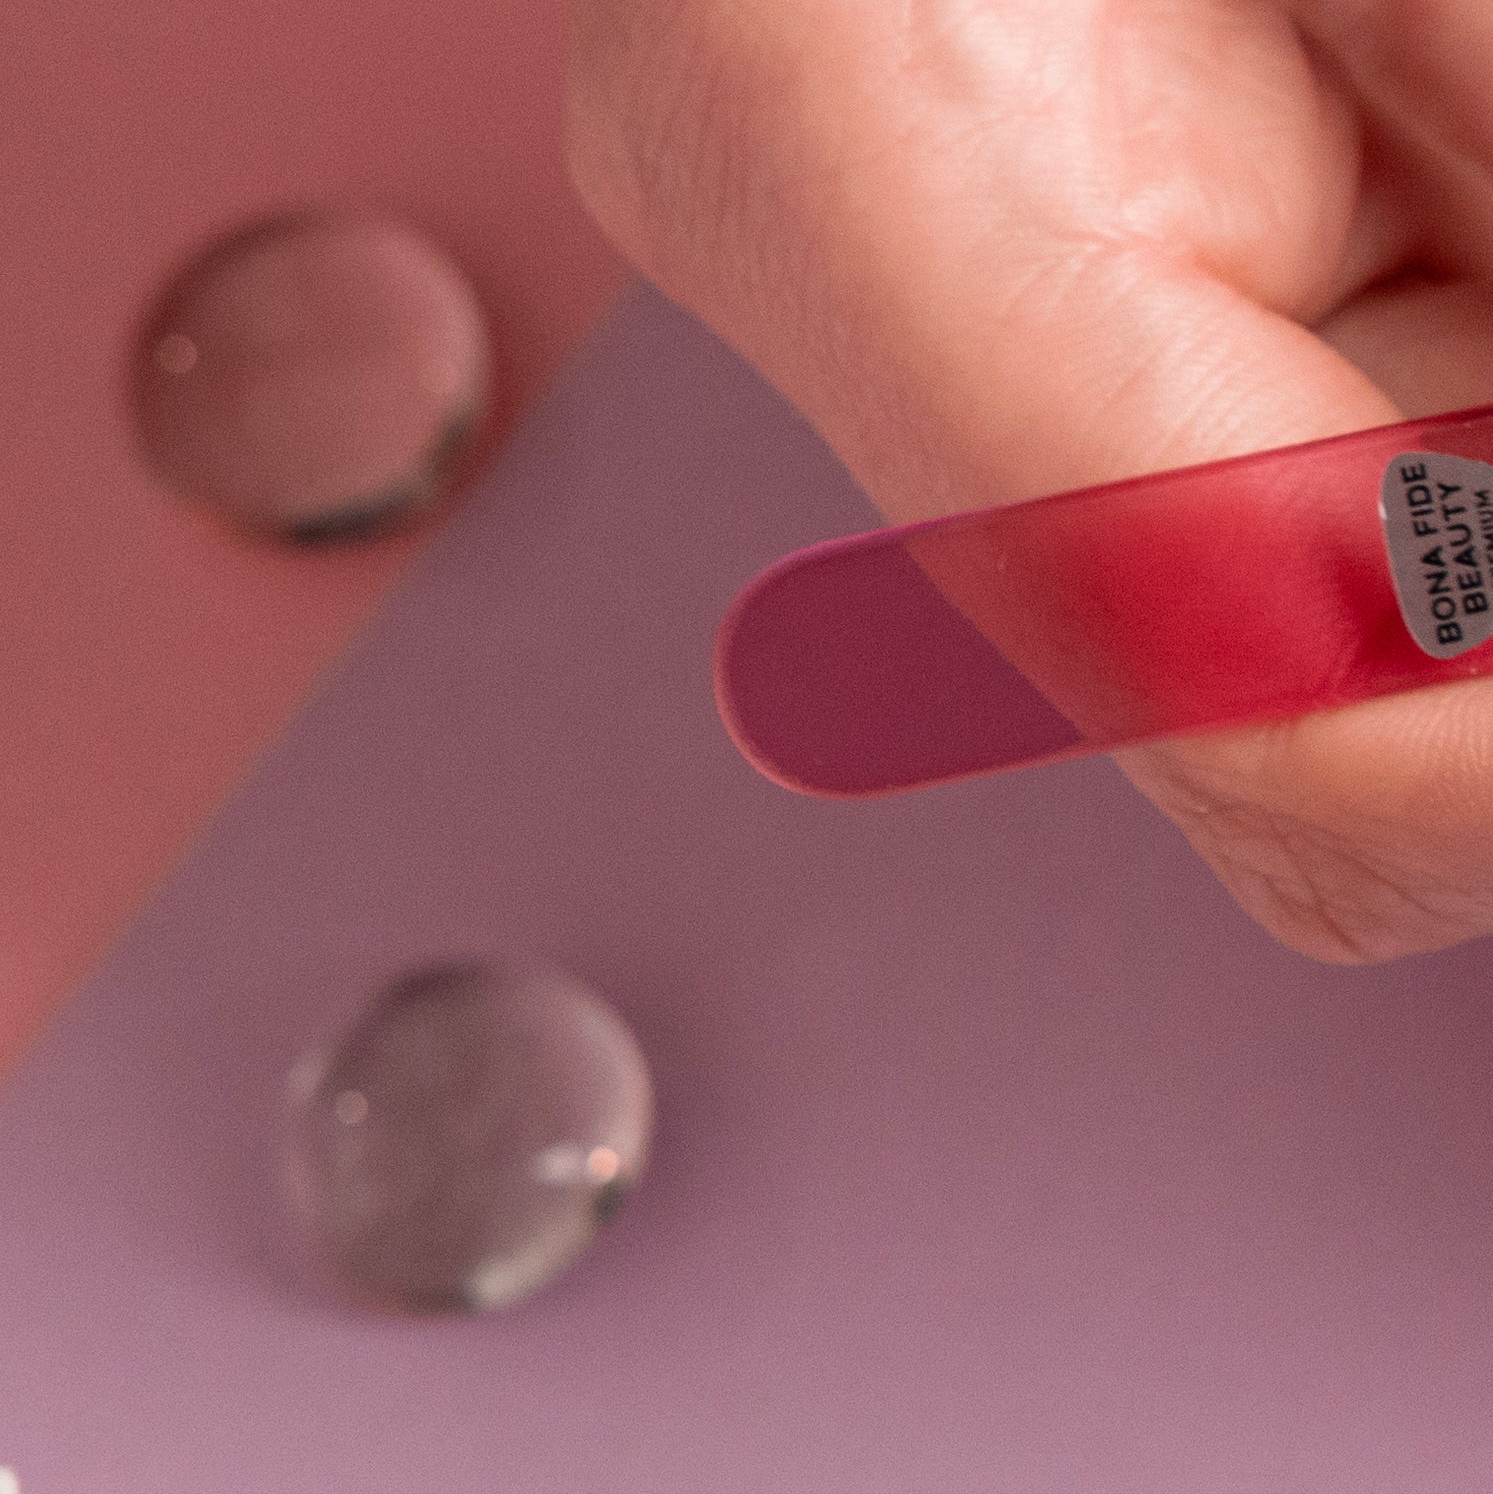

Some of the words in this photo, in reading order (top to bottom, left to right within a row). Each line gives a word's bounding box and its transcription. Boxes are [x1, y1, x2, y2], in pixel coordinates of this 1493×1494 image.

[1402, 462, 1437, 537] FIDE
[1437, 482, 1489, 614] BEAUTY
[1421, 545, 1463, 644] BONA
